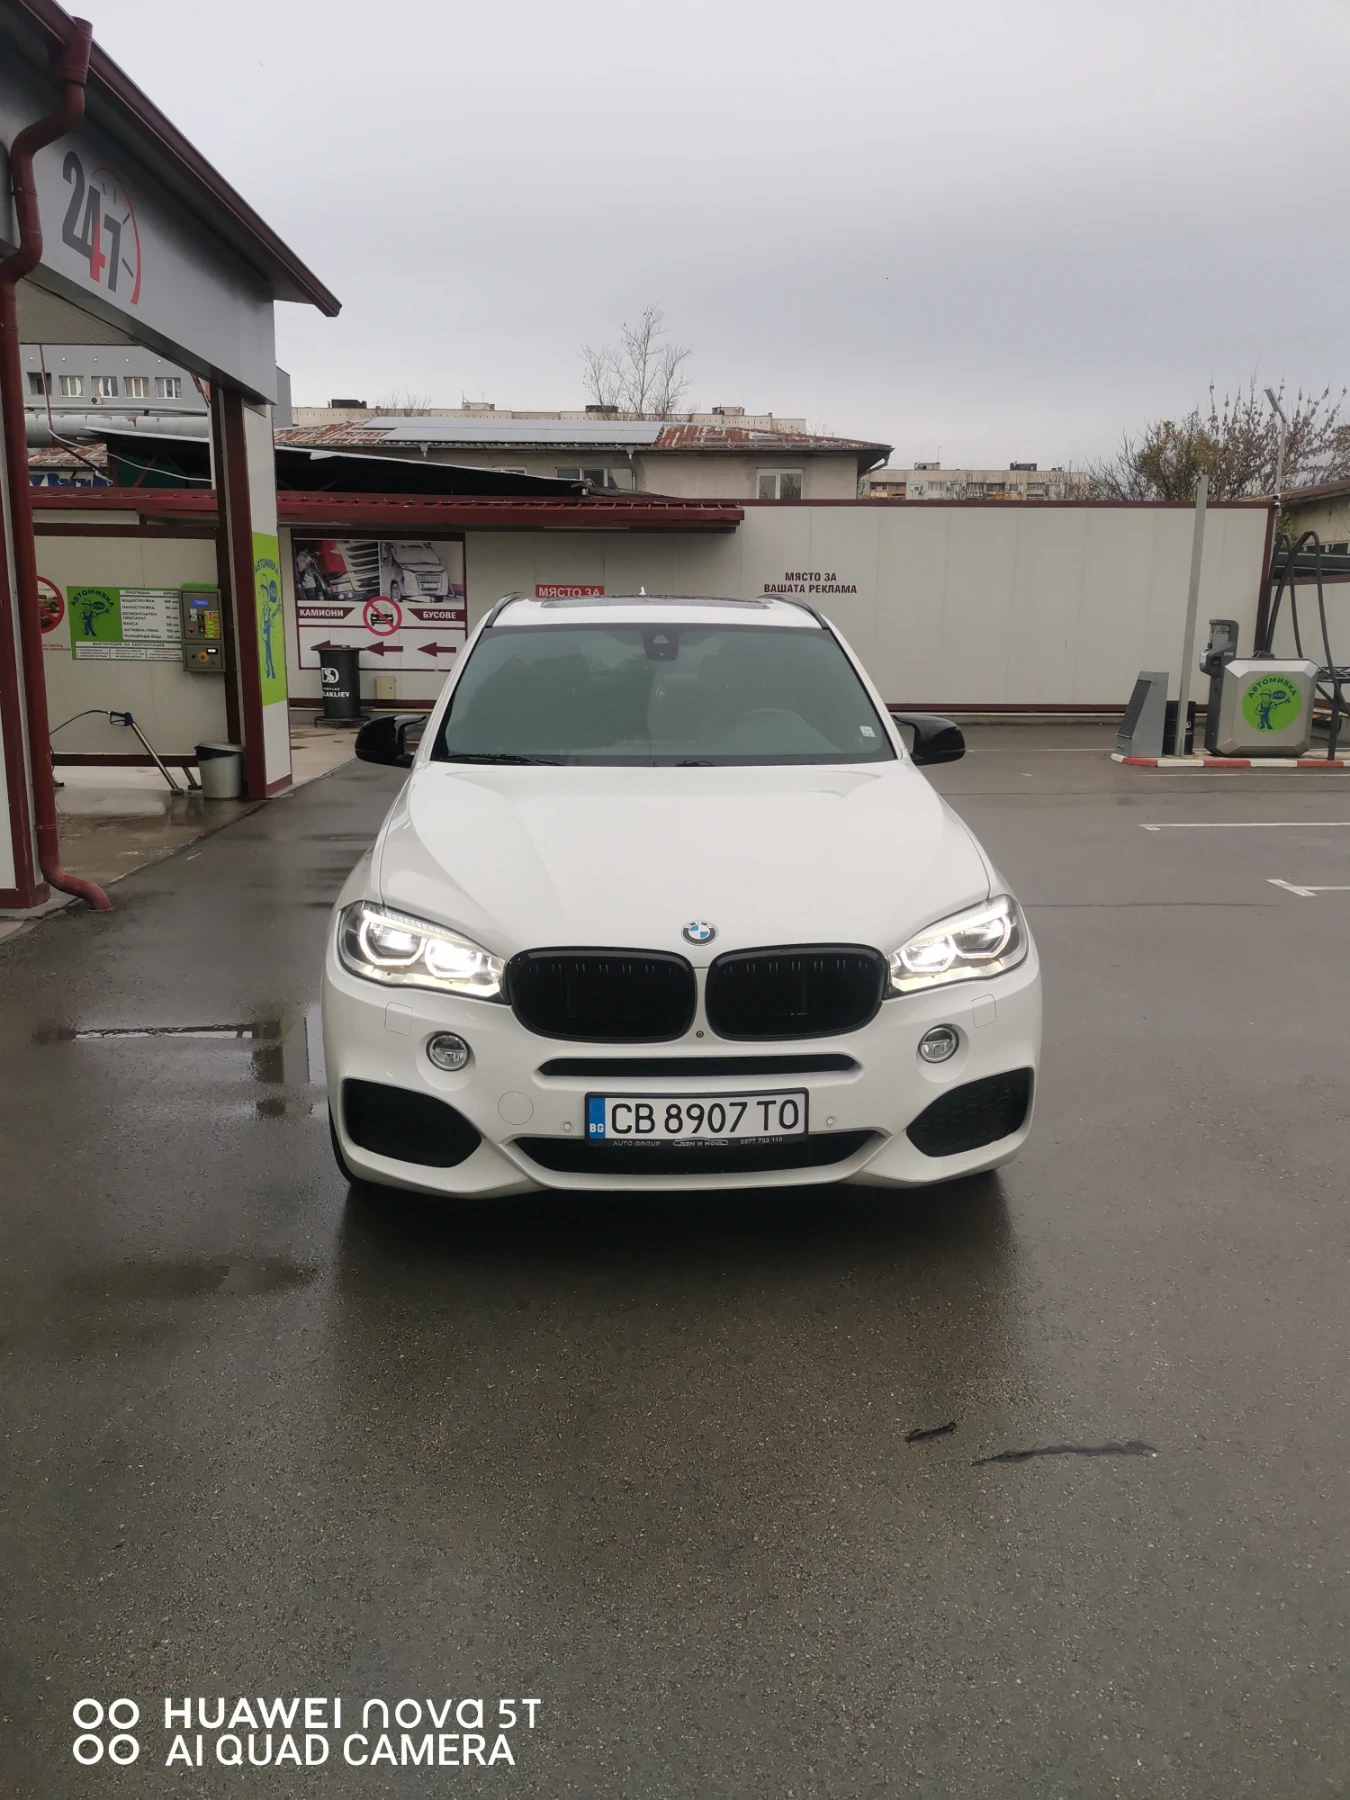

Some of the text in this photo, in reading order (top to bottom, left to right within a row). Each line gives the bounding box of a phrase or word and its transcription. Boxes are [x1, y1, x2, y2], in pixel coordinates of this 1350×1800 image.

[785, 572, 837, 581] МЯСТО ЗА
[538, 587, 600, 597] МЯСТО ЗА
[764, 584, 857, 593] ВАШАТА РЕКЛАМА
[70, 589, 114, 608] АВТОМИВКА
[299, 608, 344, 617] КАМИОНИ
[423, 611, 457, 619] БУСОВЕ
[1248, 677, 1297, 698] АВТОМИВКА
[611, 1103, 655, 1134] CB
[664, 1102, 748, 1133] 8907
[589, 1123, 604, 1133] BG
